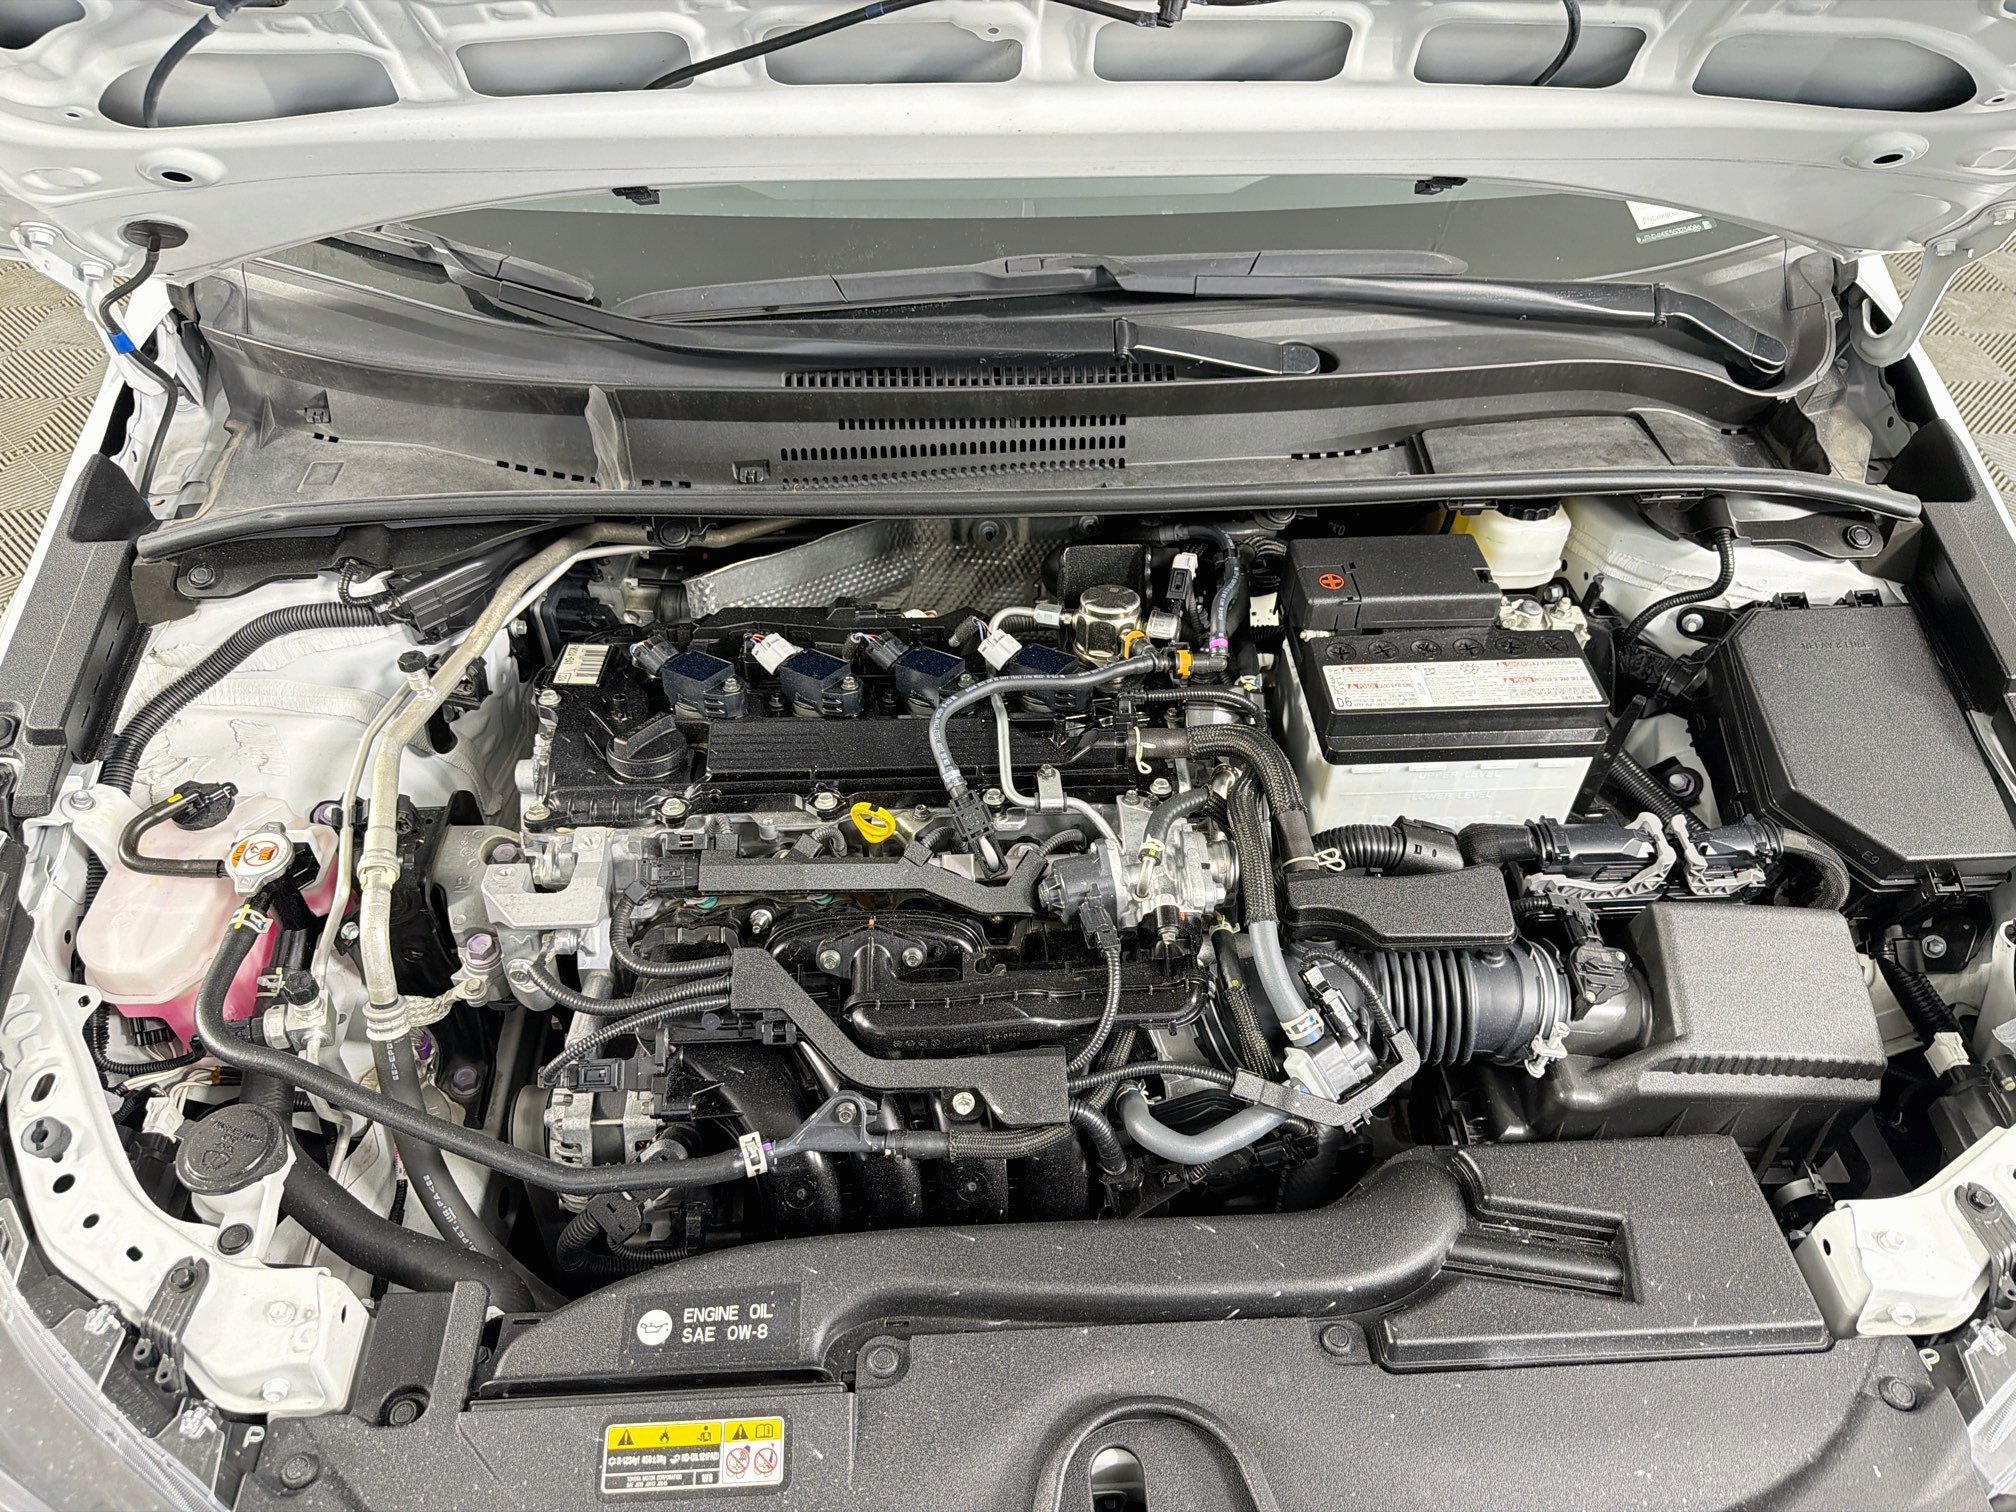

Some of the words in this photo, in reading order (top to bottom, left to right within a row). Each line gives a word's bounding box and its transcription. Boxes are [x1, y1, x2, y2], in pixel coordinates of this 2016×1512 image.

[1336, 697, 1353, 708] D6
[1861, 850, 1880, 865] E9
[683, 1305, 740, 1323] ENGINE
[749, 1302, 774, 1319] OIL
[682, 1326, 716, 1343] SAE
[727, 1323, 768, 1341] 0W-8
